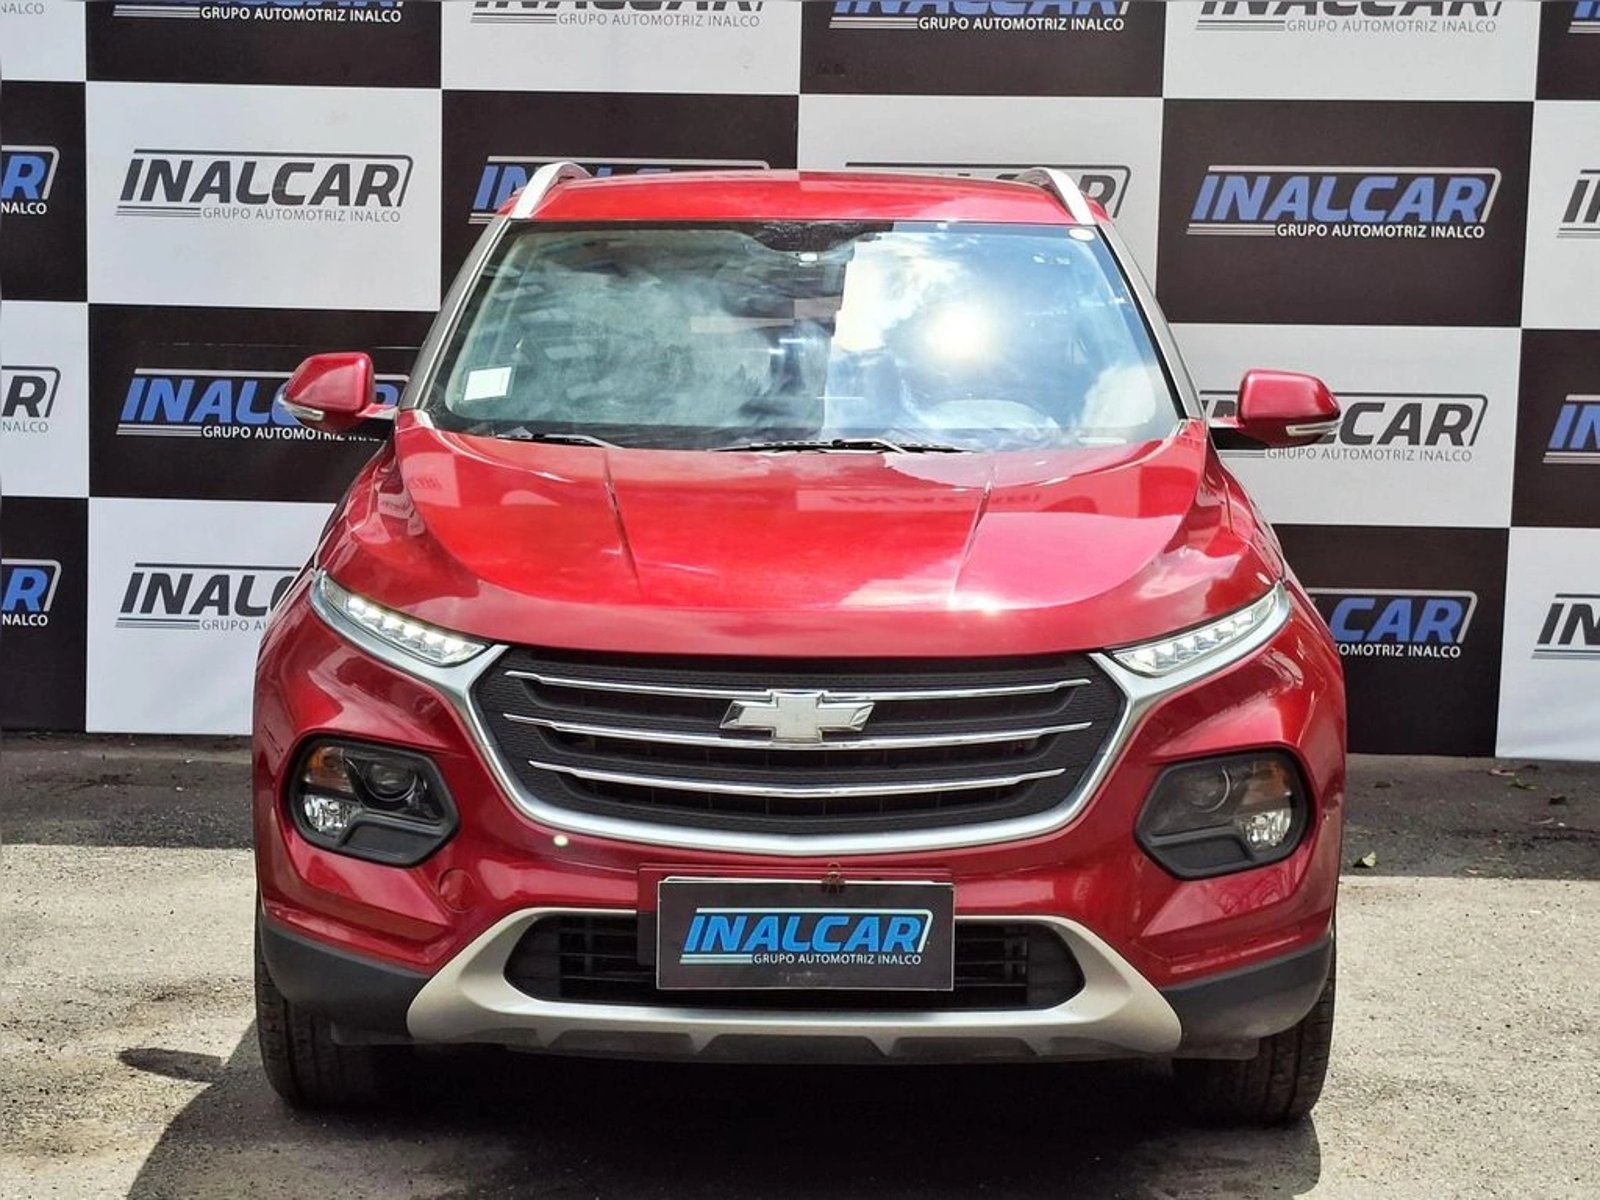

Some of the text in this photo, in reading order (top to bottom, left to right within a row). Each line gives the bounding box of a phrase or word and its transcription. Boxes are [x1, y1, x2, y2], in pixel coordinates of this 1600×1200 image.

[201, 7, 401, 23] GRUPO AUTOMOTRIZ INALCO
[559, 13, 760, 28] GRUPO AUTOMOTRIZ INALCO
[919, 17, 1125, 31] GRUPO AUTOMOTRIZ INALCO
[1287, 19, 1496, 34] GRUPO AUTOMOTRIZ INALCO
[119, 158, 400, 206] INALCAR
[1191, 175, 1487, 223] INALCAR
[203, 207, 401, 223] GRUPO AUTOMOTRIZ INALCO
[1277, 223, 1486, 239] GRUPO AUTOMOTRIZ INALCO
[203, 426, 251, 439] GRUPO
[1267, 447, 1473, 463] GRUPO AUTOMOTRIZ INALCO
[201, 619, 249, 632] GRUPO
[1408, 644, 1461, 659] INALCO
[684, 915, 922, 952] INALCAR
[753, 952, 922, 965] GRUPO AUTOMOTRIZ INALCO
